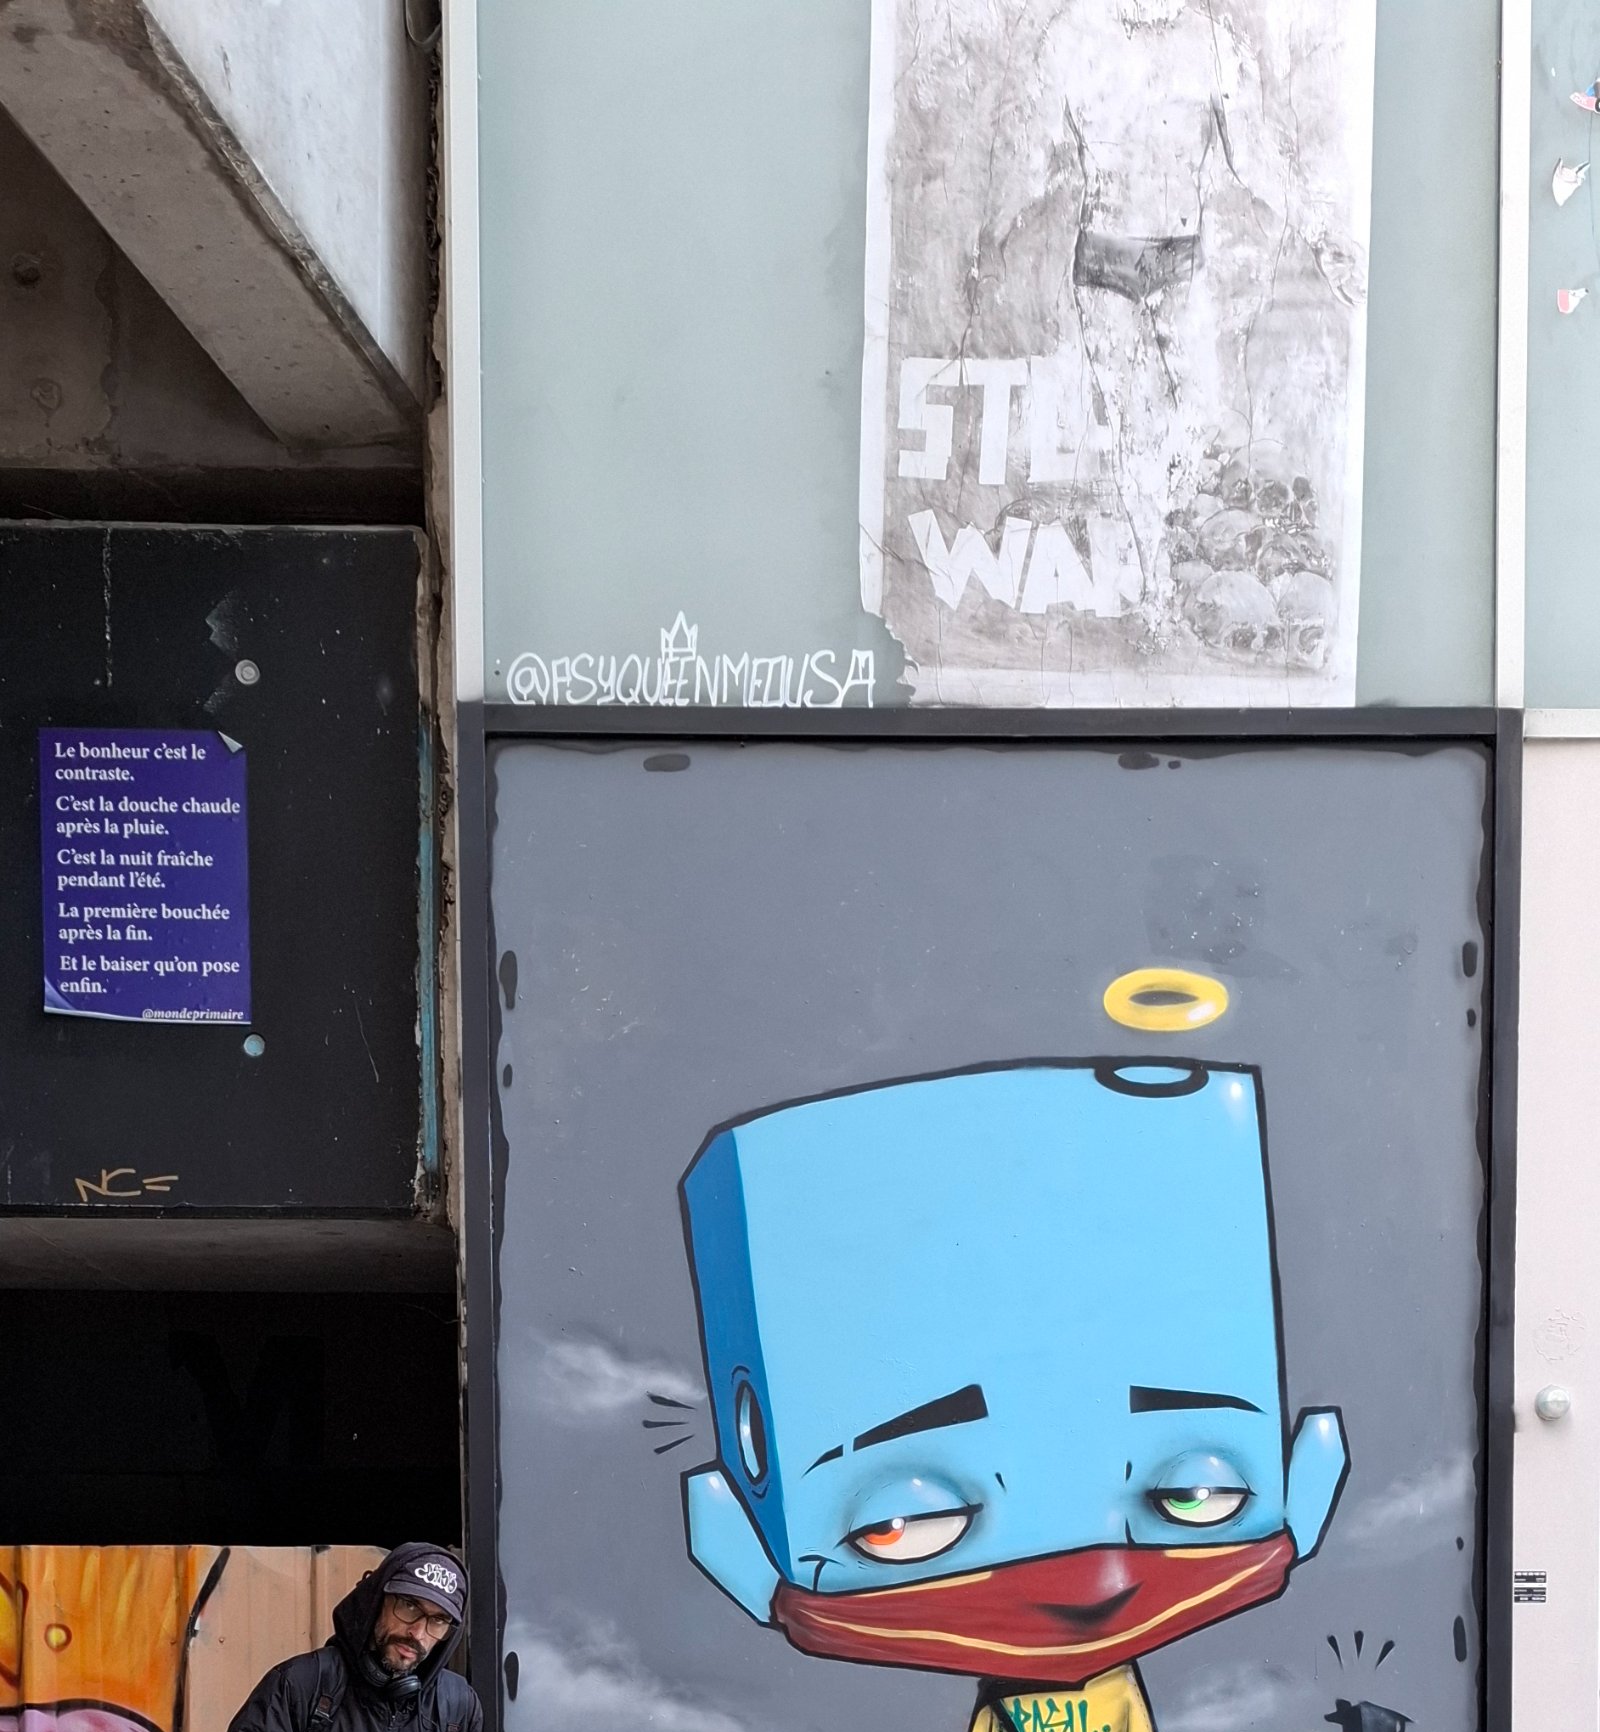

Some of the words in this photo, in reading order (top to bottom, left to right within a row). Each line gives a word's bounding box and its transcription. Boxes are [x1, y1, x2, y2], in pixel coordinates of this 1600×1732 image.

[55, 742, 76, 758] Le
[79, 742, 150, 759] bonheur
[153, 744, 187, 760] c’est
[191, 744, 206, 760] le
[55, 767, 135, 781] contraste.
[56, 796, 95, 811] C’est
[99, 797, 114, 812] la
[118, 797, 179, 813] douche
[182, 798, 241, 814] chaude
[56, 818, 101, 838] après
[104, 819, 119, 834] la
[123, 819, 169, 839] pluie.
[57, 849, 97, 865] C’est
[100, 850, 115, 865] la
[119, 851, 153, 867] nuit
[157, 850, 214, 867] fraîche
[57, 871, 126, 891] pendant
[129, 872, 166, 888] l’été.
[58, 903, 80, 918] La
[83, 904, 158, 922] première
[160, 904, 230, 920] bouchée
[58, 925, 103, 944] après
[106, 925, 122, 940] la
[125, 925, 153, 941] fin.
[60, 956, 78, 971] Et
[81, 956, 97, 971] le
[100, 956, 150, 972] baiser
[153, 956, 199, 976] qu’on
[202, 960, 241, 976] pose
[60, 977, 108, 993] enfin.
[142, 1007, 244, 1021] @mondeprimaire
